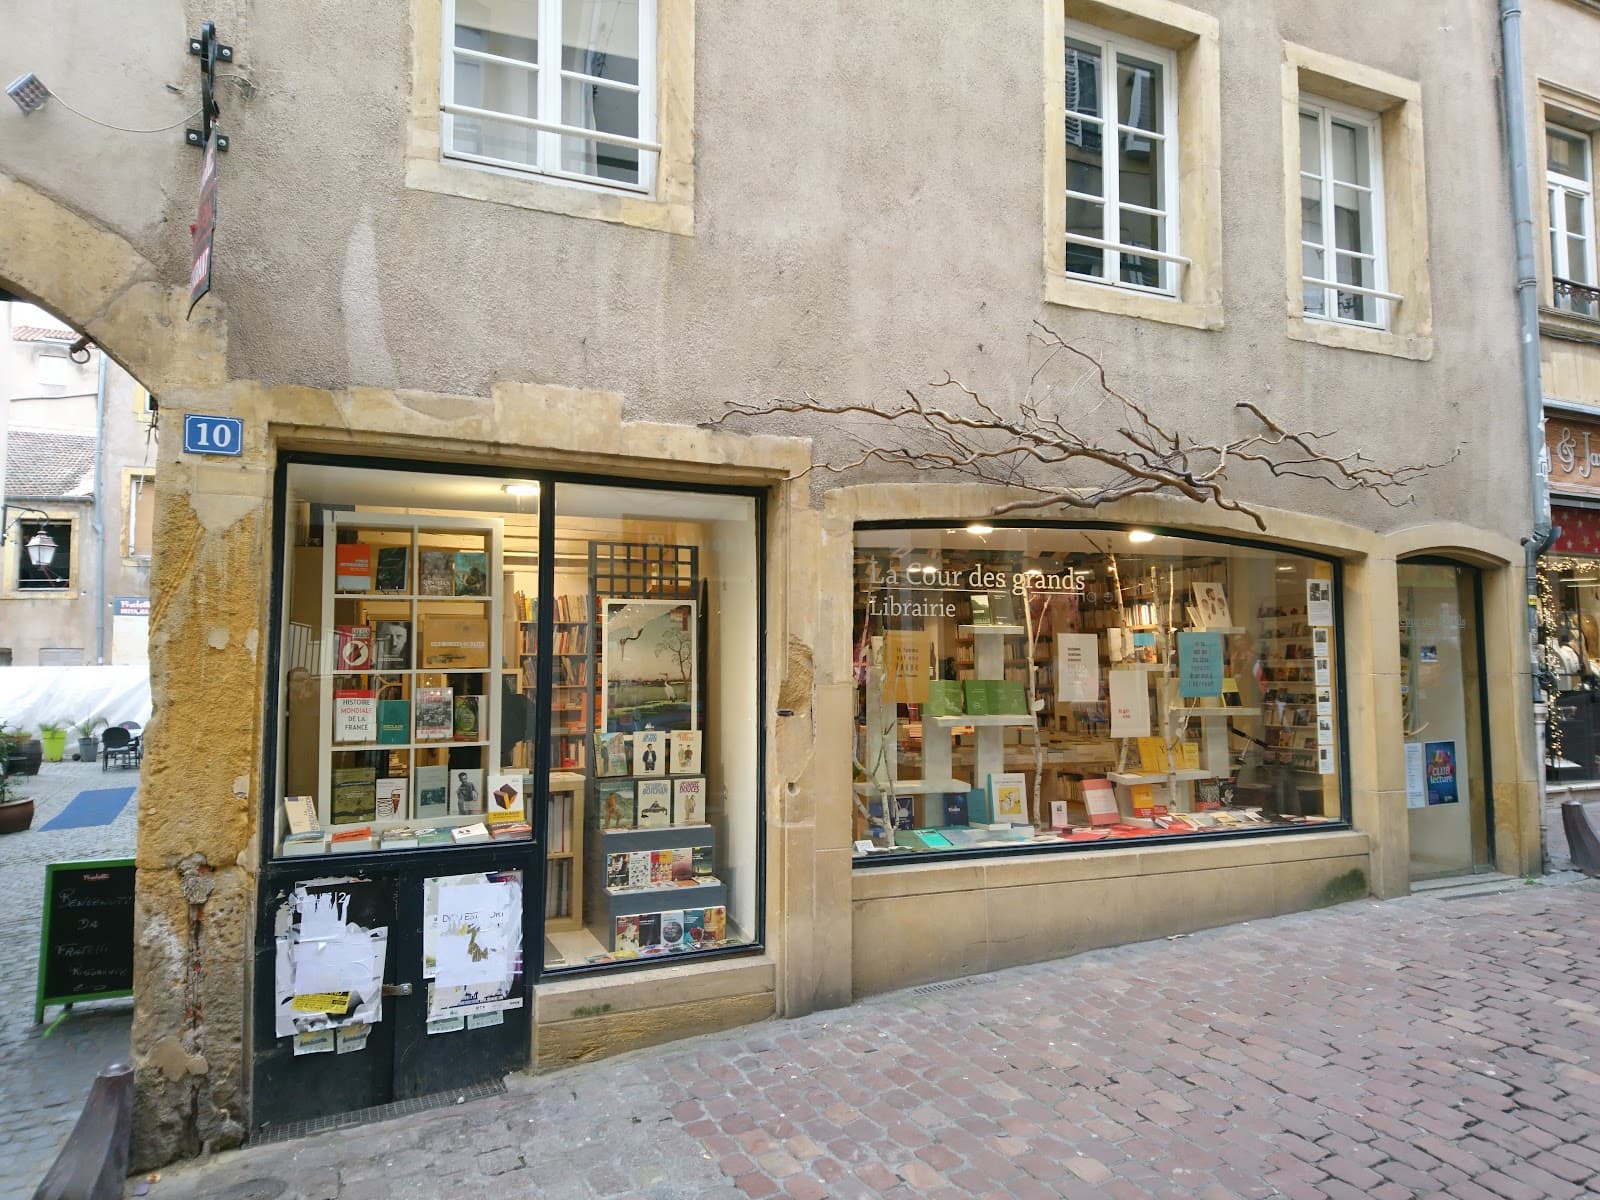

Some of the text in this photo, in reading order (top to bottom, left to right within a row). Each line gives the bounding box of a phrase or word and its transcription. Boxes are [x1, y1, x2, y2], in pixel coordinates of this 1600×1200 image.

[197, 423, 231, 447] 10
[870, 556, 1085, 595] La Cour des grands
[870, 595, 956, 617] Librairie
